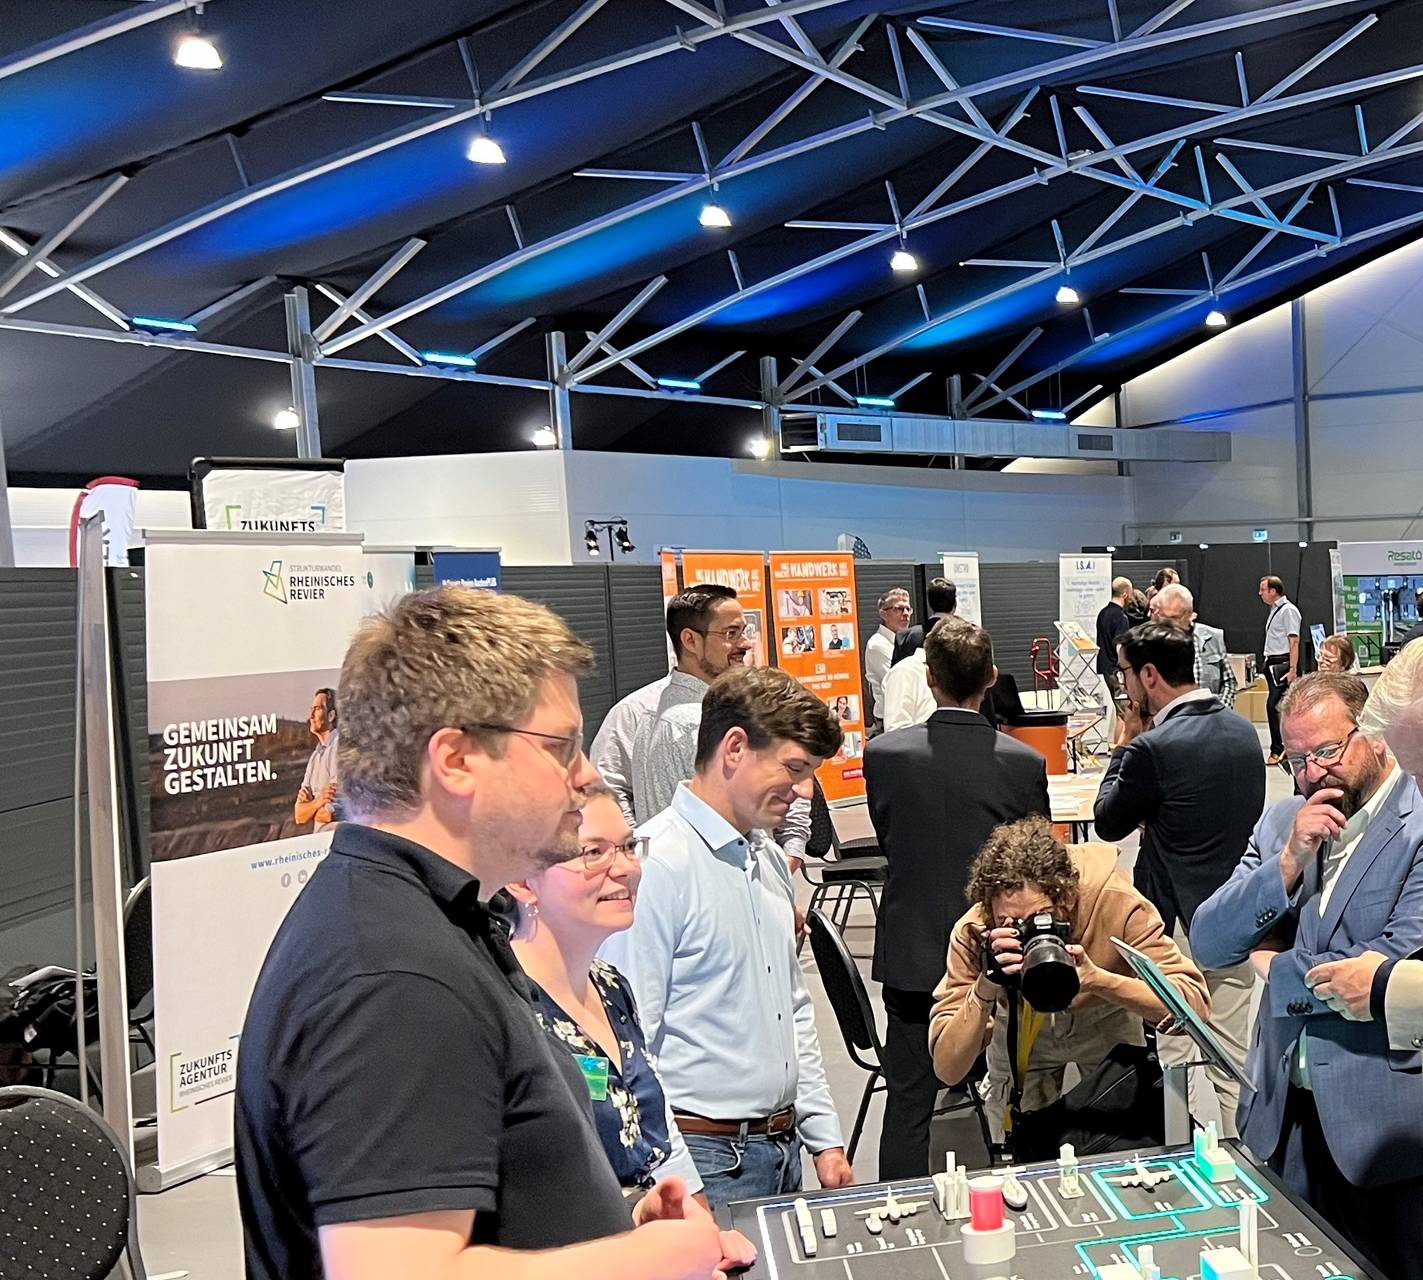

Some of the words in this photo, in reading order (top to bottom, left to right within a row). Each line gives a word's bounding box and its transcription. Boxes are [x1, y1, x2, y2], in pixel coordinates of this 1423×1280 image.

[289, 575, 355, 588] RHEINISCHES
[790, 562, 838, 577] HANDWERK
[290, 589, 325, 600] REVIER
[163, 713, 277, 746] GEMEINSAM
[163, 738, 255, 771] ZUKUNFT
[164, 759, 278, 795] GESTALTEN.
[250, 848, 329, 869] www.rheinisches-r
[180, 1049, 233, 1075] ZUKUNFTS
[179, 1063, 227, 1088] AGENTUR
